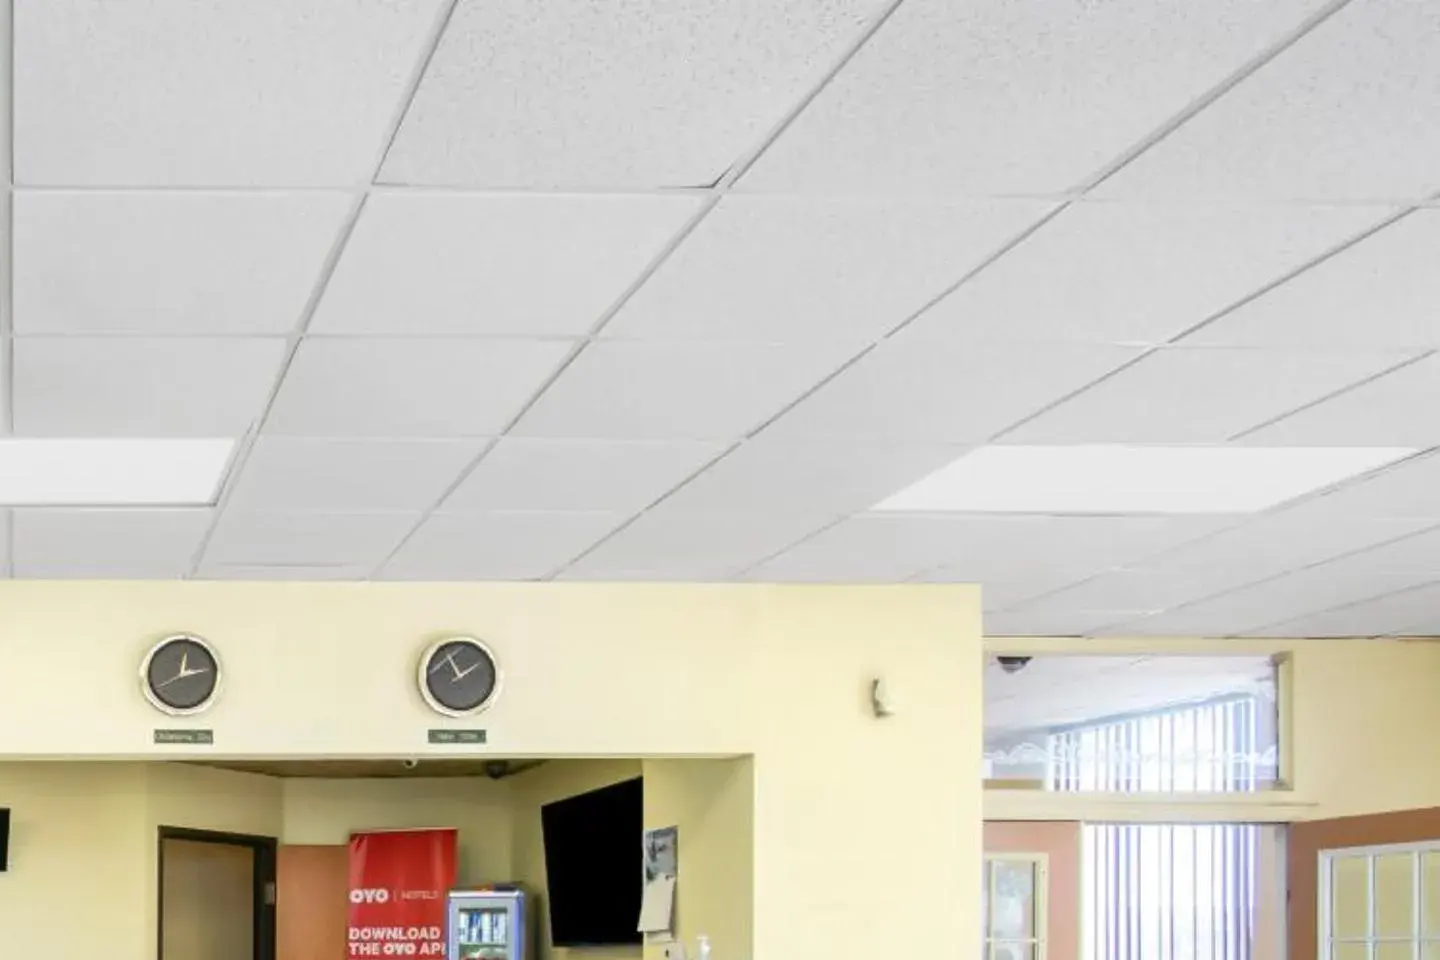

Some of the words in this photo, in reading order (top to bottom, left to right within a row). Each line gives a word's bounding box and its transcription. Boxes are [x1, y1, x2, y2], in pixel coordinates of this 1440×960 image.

[349, 887, 389, 903] OYO
[348, 927, 441, 940] DOWNLOAD
[348, 942, 380, 955] THE
[383, 942, 417, 955] OYO
